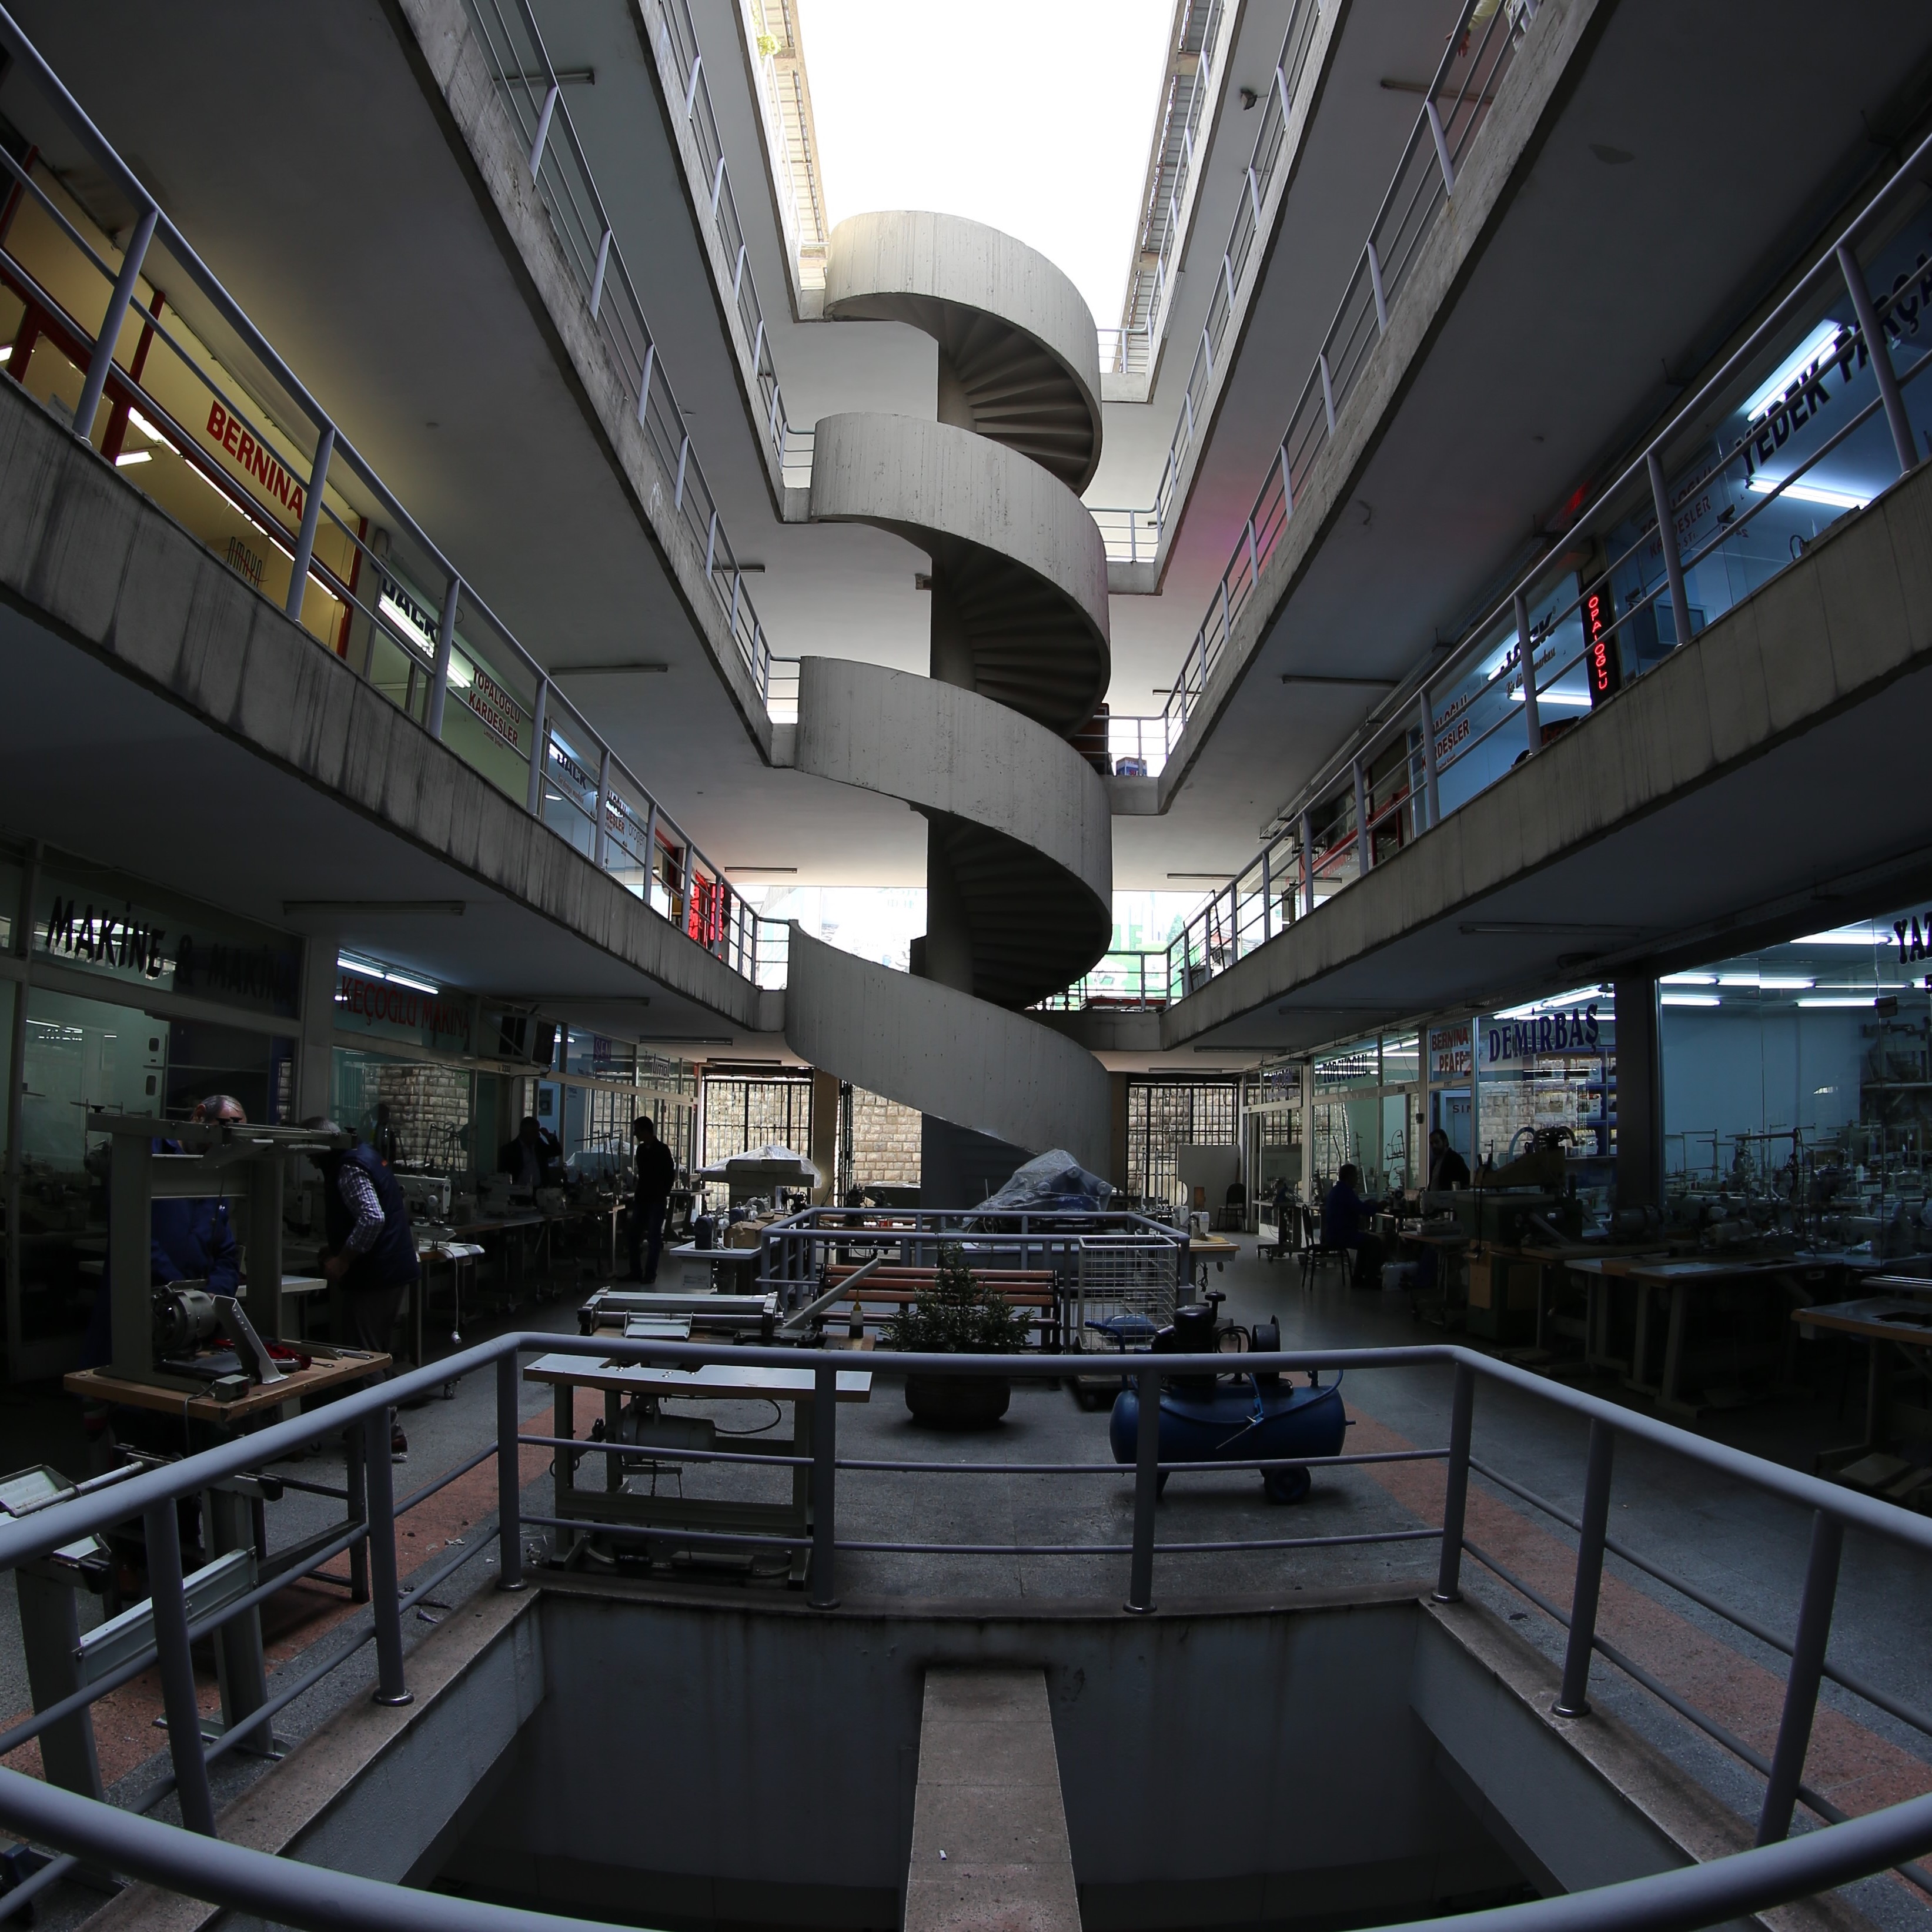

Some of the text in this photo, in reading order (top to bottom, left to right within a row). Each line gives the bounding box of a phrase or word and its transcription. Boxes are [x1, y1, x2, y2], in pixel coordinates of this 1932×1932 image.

[1735, 360, 1830, 476] YEDEK
[206, 400, 303, 522] BERNINA
[45, 896, 166, 978] MAKİNE
[177, 935, 194, 986] &
[340, 975, 417, 1027] KEÇOĞLU
[1432, 1027, 1469, 1051] BERNINA
[1489, 1003, 1599, 1062] DEMİRBAŞ
[1439, 1051, 1464, 1074] PFAFF
